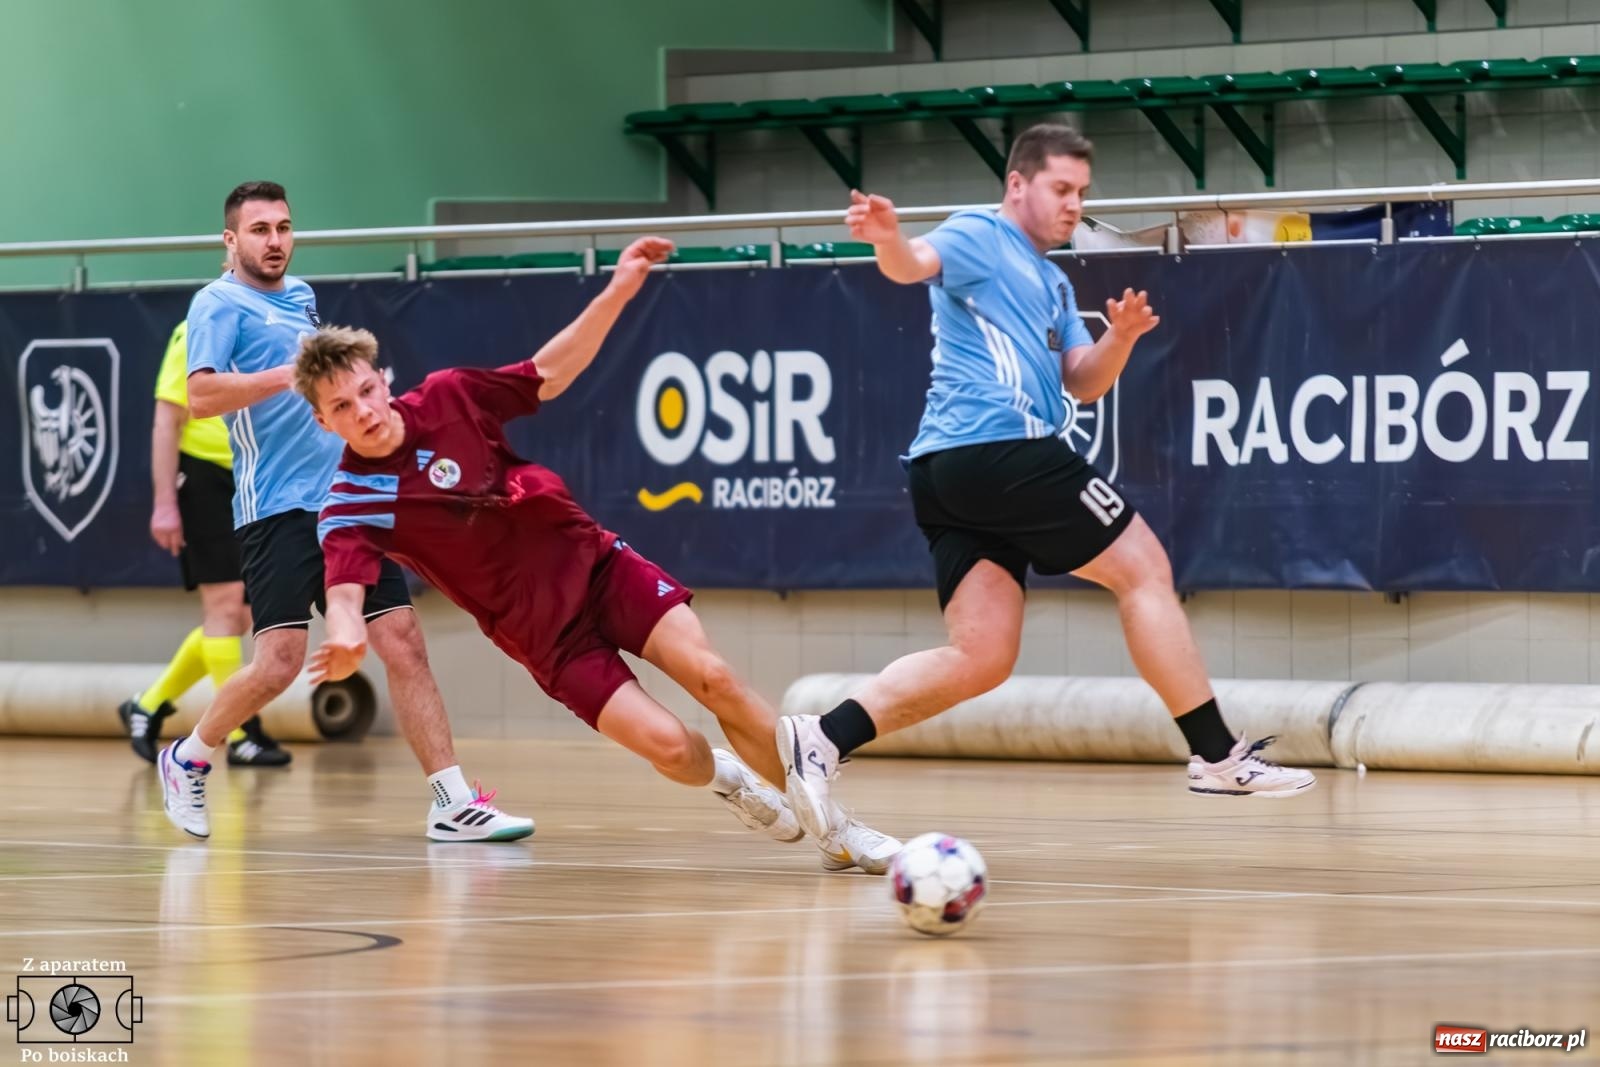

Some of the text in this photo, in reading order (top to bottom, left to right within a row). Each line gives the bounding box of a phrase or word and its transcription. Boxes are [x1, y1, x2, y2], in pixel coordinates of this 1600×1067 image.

[1191, 338, 1590, 466] RACIBÓRZ
[713, 467, 836, 508] RACIBÓRZ
[1079, 477, 1125, 527] 19
